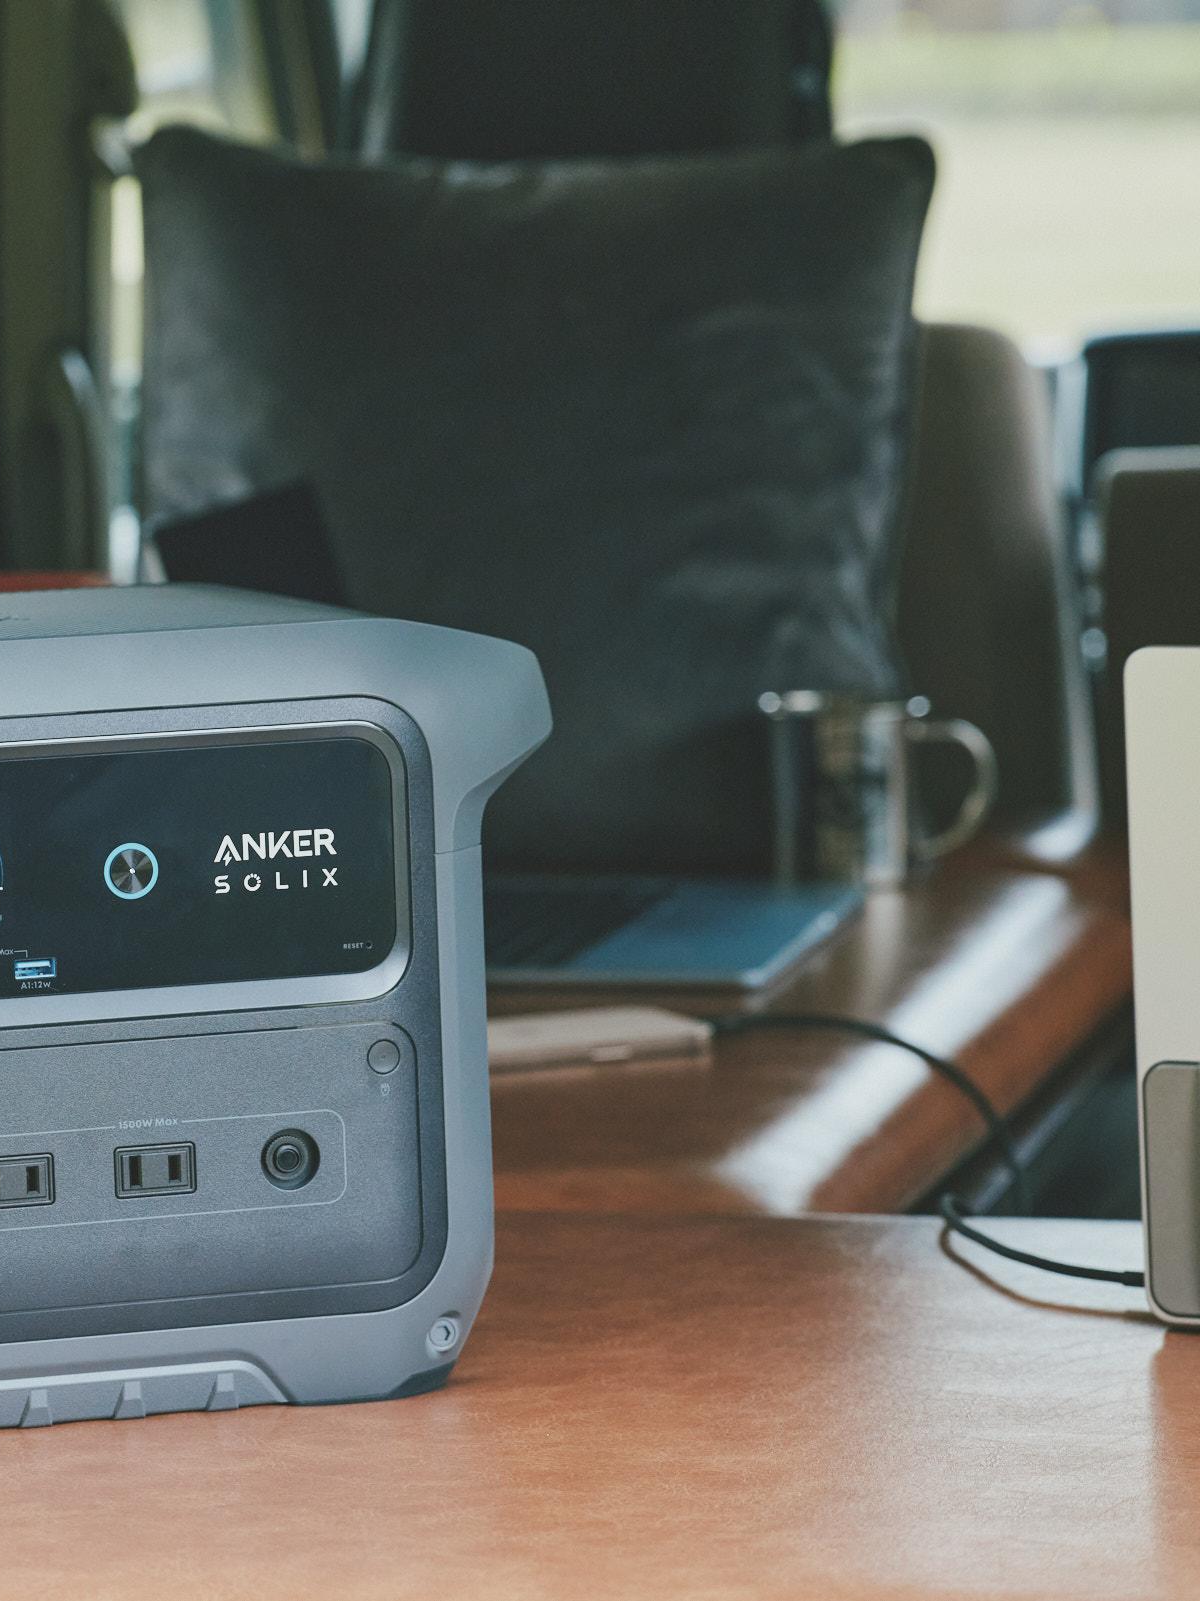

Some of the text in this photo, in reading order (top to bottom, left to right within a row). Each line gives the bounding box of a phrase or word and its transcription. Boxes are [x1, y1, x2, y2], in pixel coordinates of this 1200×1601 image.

[214, 828, 337, 866] ANKER
[214, 867, 338, 894] SOLIX
[118, 1118, 178, 1129] 1500W Max
